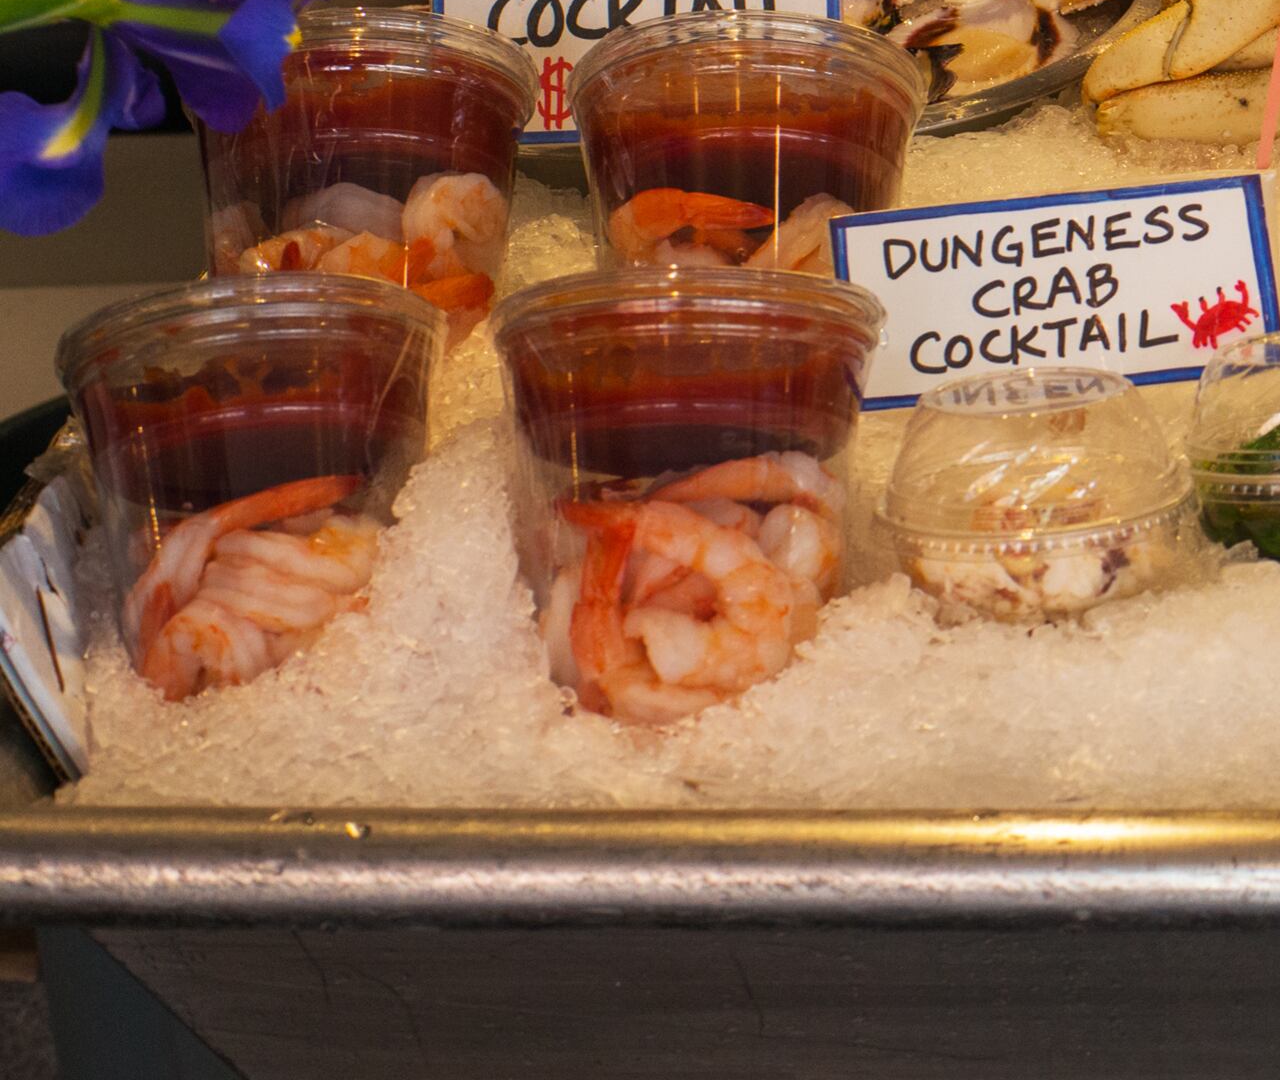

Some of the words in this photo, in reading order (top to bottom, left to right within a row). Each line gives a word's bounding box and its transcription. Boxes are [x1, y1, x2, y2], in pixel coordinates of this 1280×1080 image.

[882, 203, 1210, 281] DUNGENESS
[972, 262, 1120, 319] CRAB
[909, 308, 1180, 375] COCKTAIL
